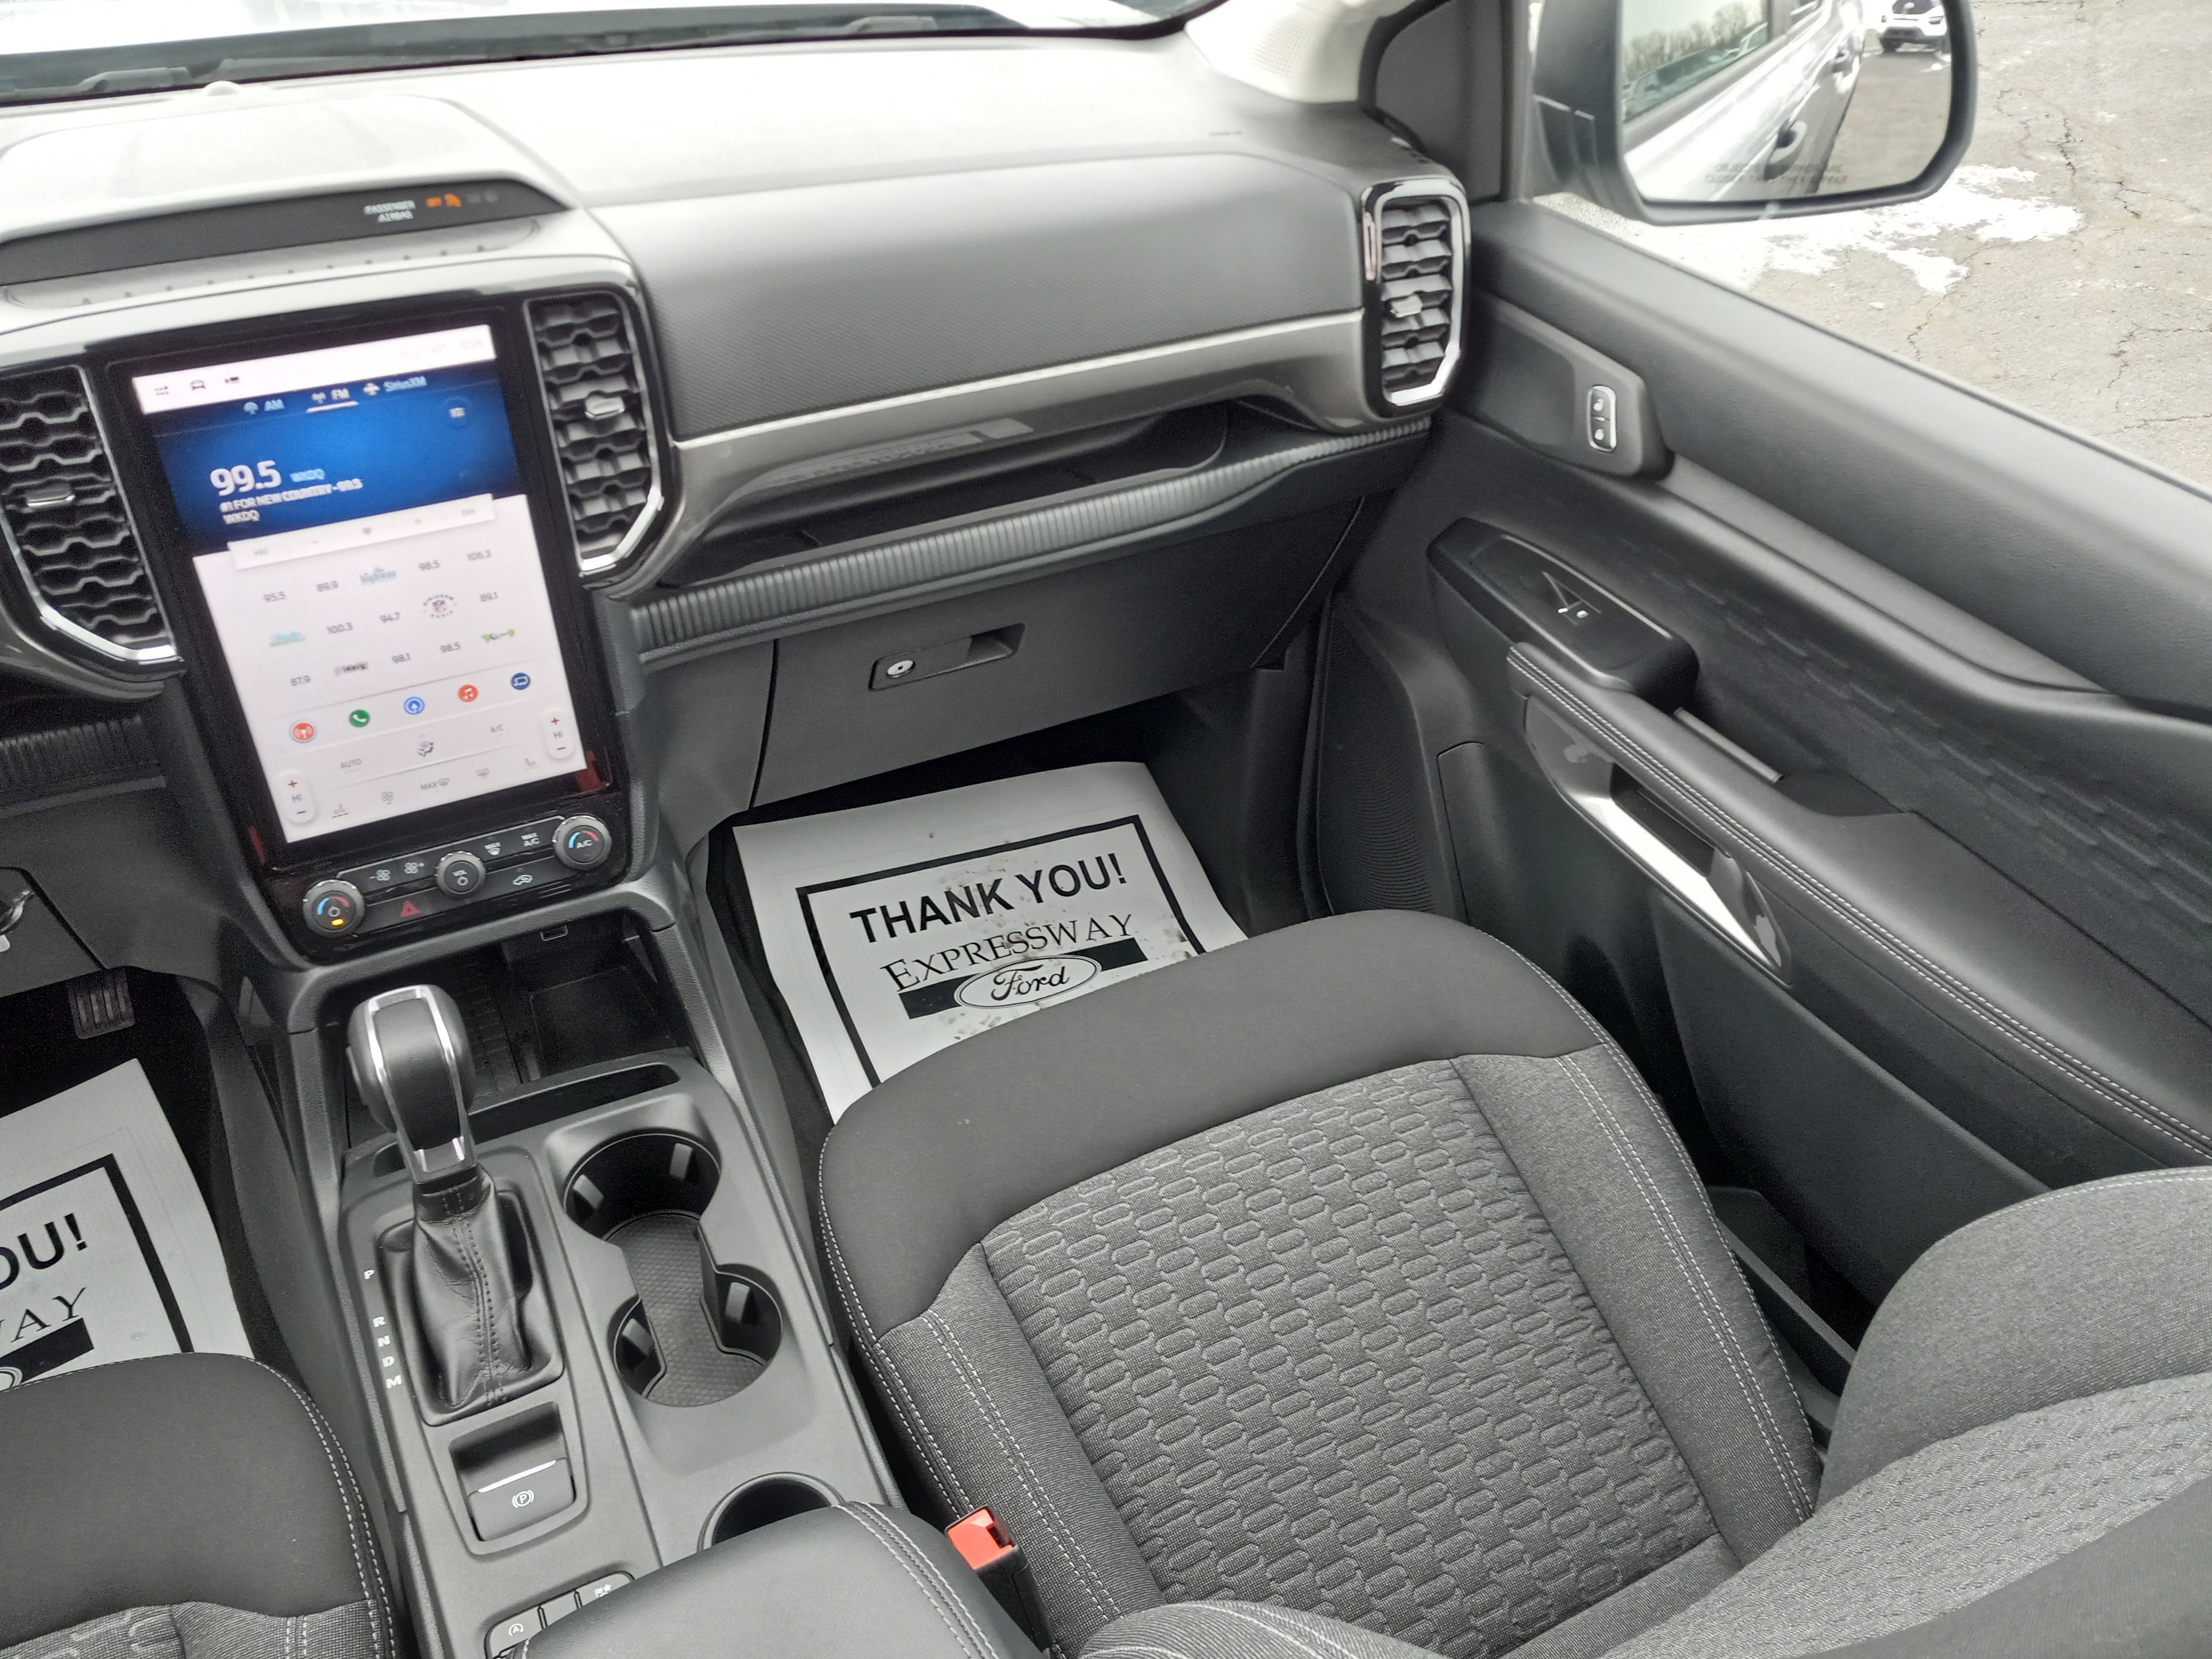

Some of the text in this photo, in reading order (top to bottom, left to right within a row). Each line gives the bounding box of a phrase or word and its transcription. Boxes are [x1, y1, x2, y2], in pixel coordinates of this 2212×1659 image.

[330, 388, 350, 400] FM
[264, 398, 285, 412] AM
[210, 459, 282, 496] 99.5
[264, 591, 286, 602] 95.5
[326, 622, 353, 635] 100.3
[440, 641, 461, 653] 98.5
[490, 724, 504, 733] A/C
[553, 730, 564, 739] HI
[340, 758, 363, 769] AUTO
[420, 781, 438, 791] MAX
[523, 837, 541, 848] A/C
[576, 839, 593, 849] A/C
[849, 853, 1127, 943] THANK YOU!
[880, 913, 1132, 992] EXPRESSWAY
[990, 964, 1070, 1001] Ford
[363, 1269, 375, 1280] P
[0, 1287, 87, 1343] AY
[373, 1316, 386, 1328] R
[377, 1334, 391, 1347] N
[382, 1356, 395, 1368] D
[385, 1374, 403, 1389] M
